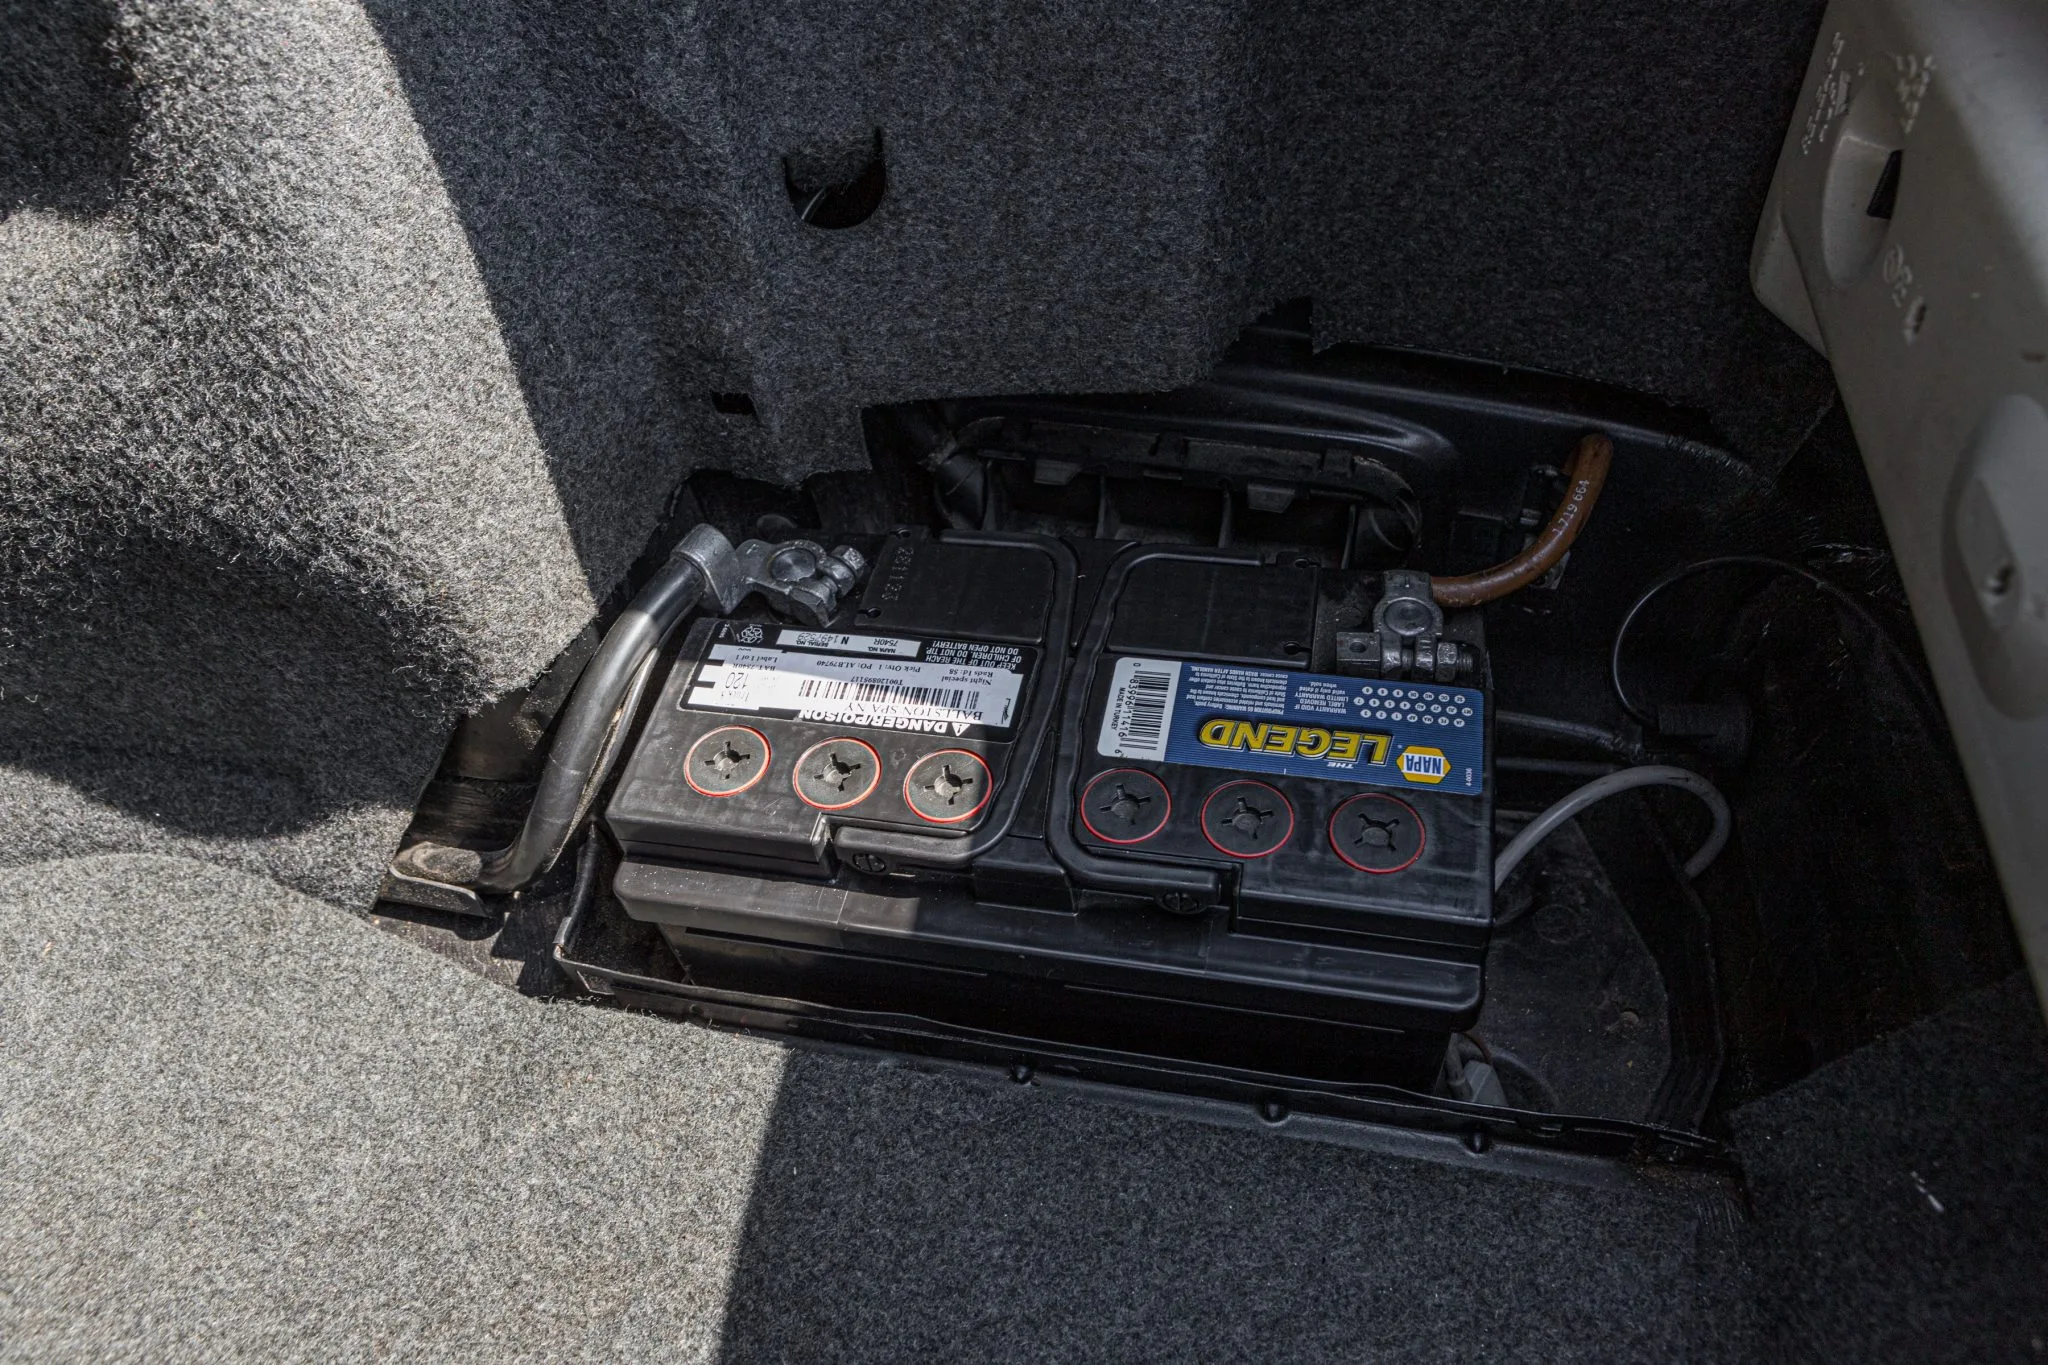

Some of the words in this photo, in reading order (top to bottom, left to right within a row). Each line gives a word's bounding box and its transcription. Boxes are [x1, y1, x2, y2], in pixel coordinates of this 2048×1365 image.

[873, 638, 898, 647] 7540R
[931, 640, 968, 650] BATTERY!
[968, 644, 989, 652] OPEN
[990, 646, 1007, 654] NOT
[1007, 647, 1019, 655] DO
[925, 654, 951, 663] REACH
[956, 650, 968, 658] DO
[969, 651, 1011, 662] CHILDREN.
[756, 655, 778, 663] Label
[951, 657, 966, 665] THE
[1010, 655, 1022, 663] OF
[979, 660, 996, 668] OUT
[996, 662, 1017, 670] KEEP
[903, 665, 921, 673] Pick
[973, 670, 994, 678] Rads
[724, 671, 750, 690] 120
[940, 674, 969, 684] special
[969, 677, 993, 686] Night
[1116, 687, 1126, 702] MADE
[1125, 678, 1139, 706] 83996
[1294, 691, 1325, 700] WARRANTY
[1326, 694, 1349, 702] LIMITED
[1315, 706, 1347, 714] WARRANTY
[797, 709, 949, 733] DANGER/POISON
[1110, 709, 1121, 730] TURKEY
[1118, 710, 1131, 738] 11416
[1199, 719, 1395, 767] LEGEND
[1326, 761, 1354, 769] THE
[1404, 754, 1442, 775] NAPA
